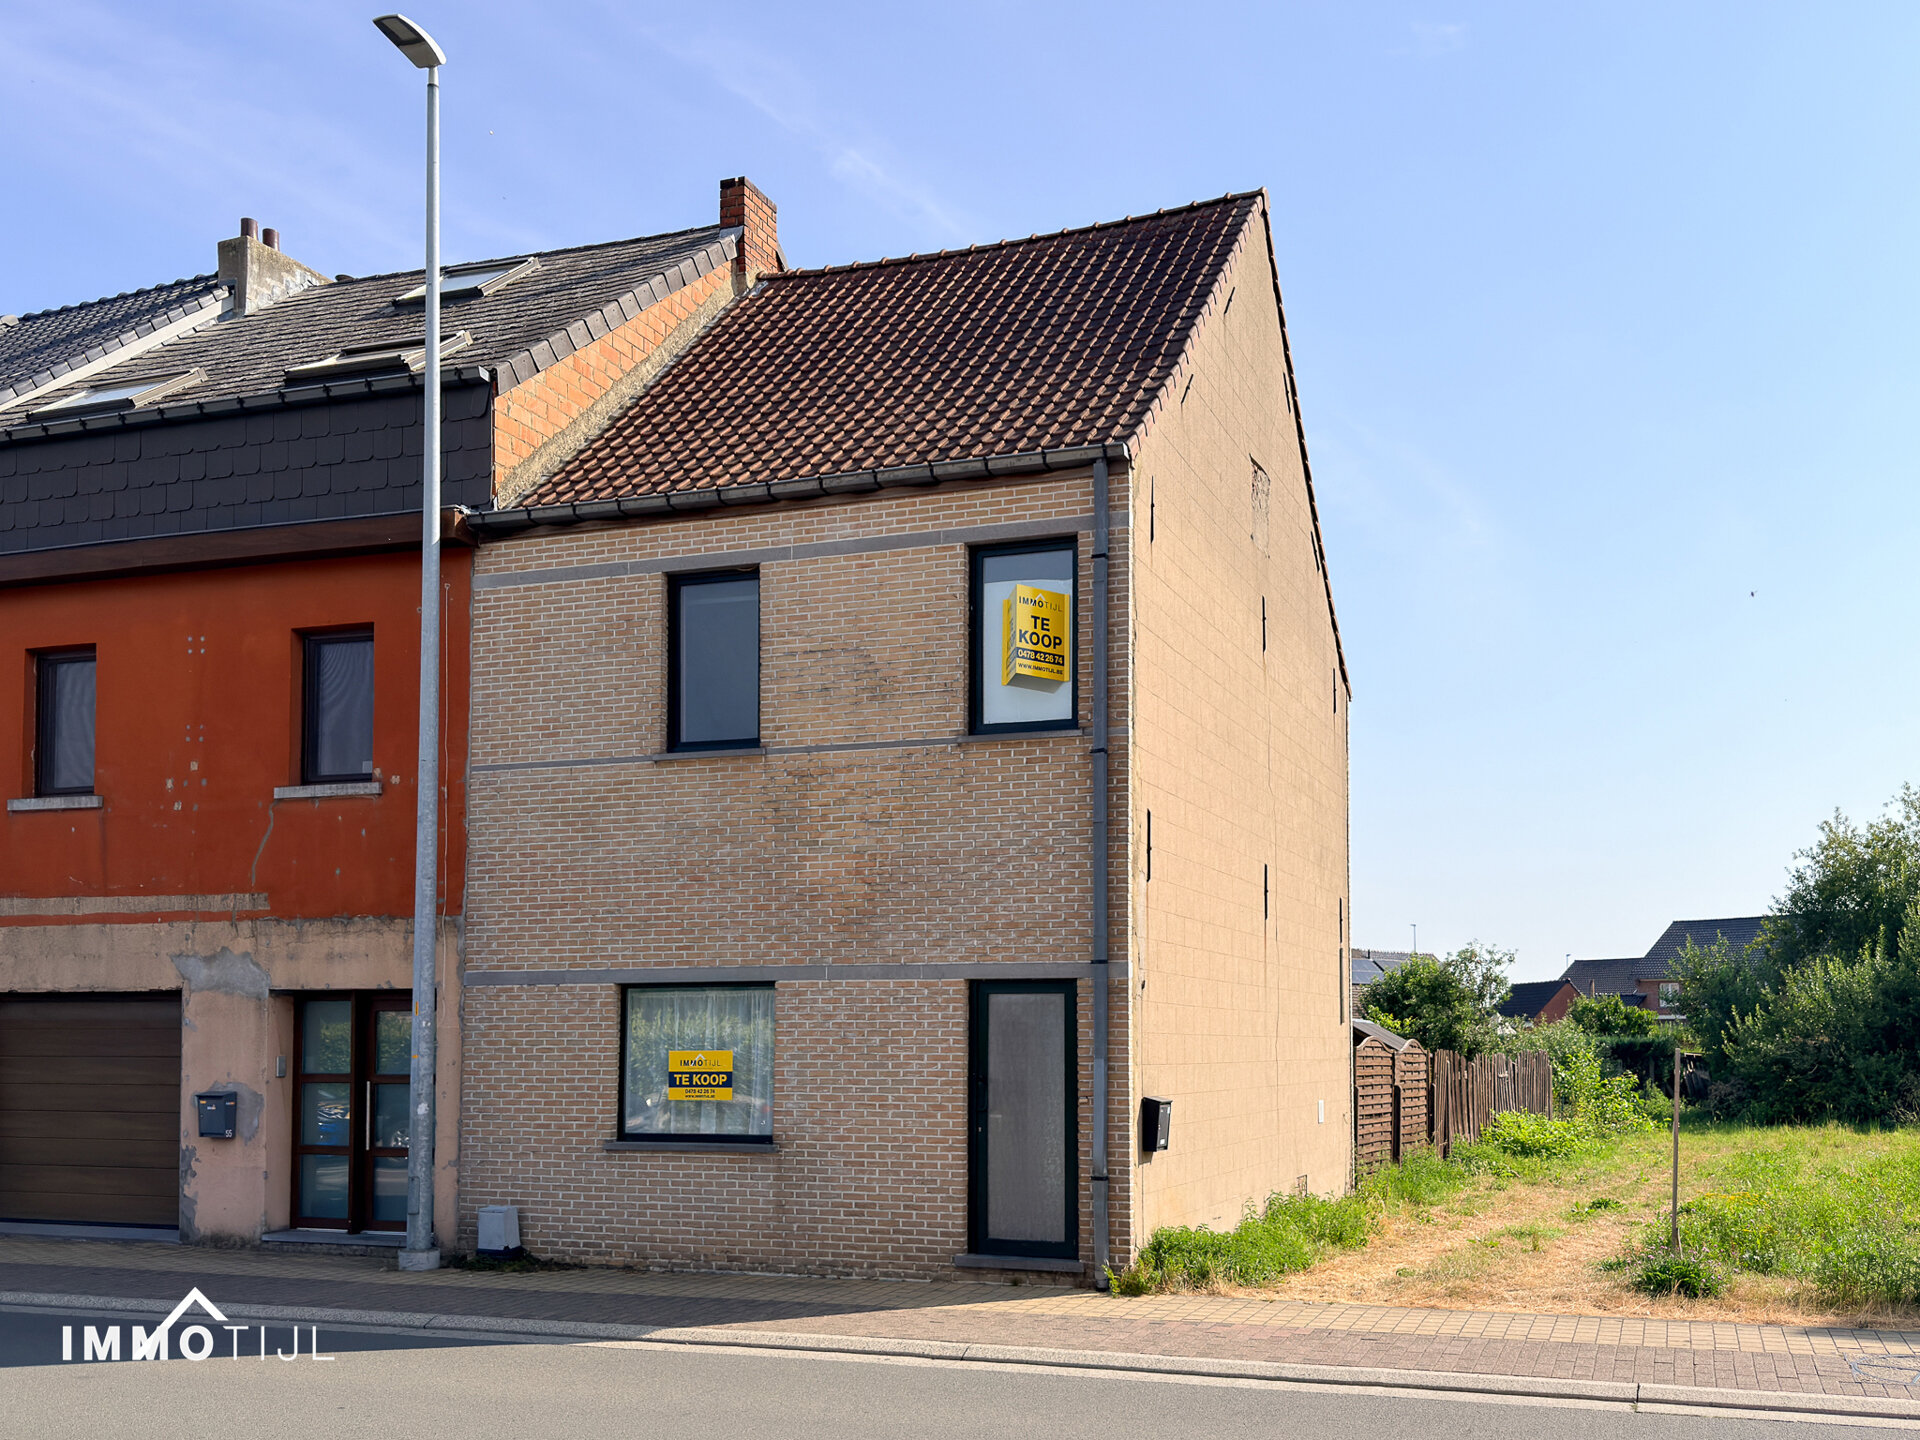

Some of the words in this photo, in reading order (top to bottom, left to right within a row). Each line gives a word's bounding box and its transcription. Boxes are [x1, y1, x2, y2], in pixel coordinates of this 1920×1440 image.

[1018, 596, 1062, 612] IMMOTIJL
[1031, 615, 1050, 632] TE
[1019, 629, 1062, 649] KOOP
[1018, 649, 1035, 660] 0478
[1036, 652, 1045, 662] 42
[1054, 656, 1063, 664] 74
[674, 1074, 690, 1085] TE
[693, 1074, 727, 1085] KOOP
